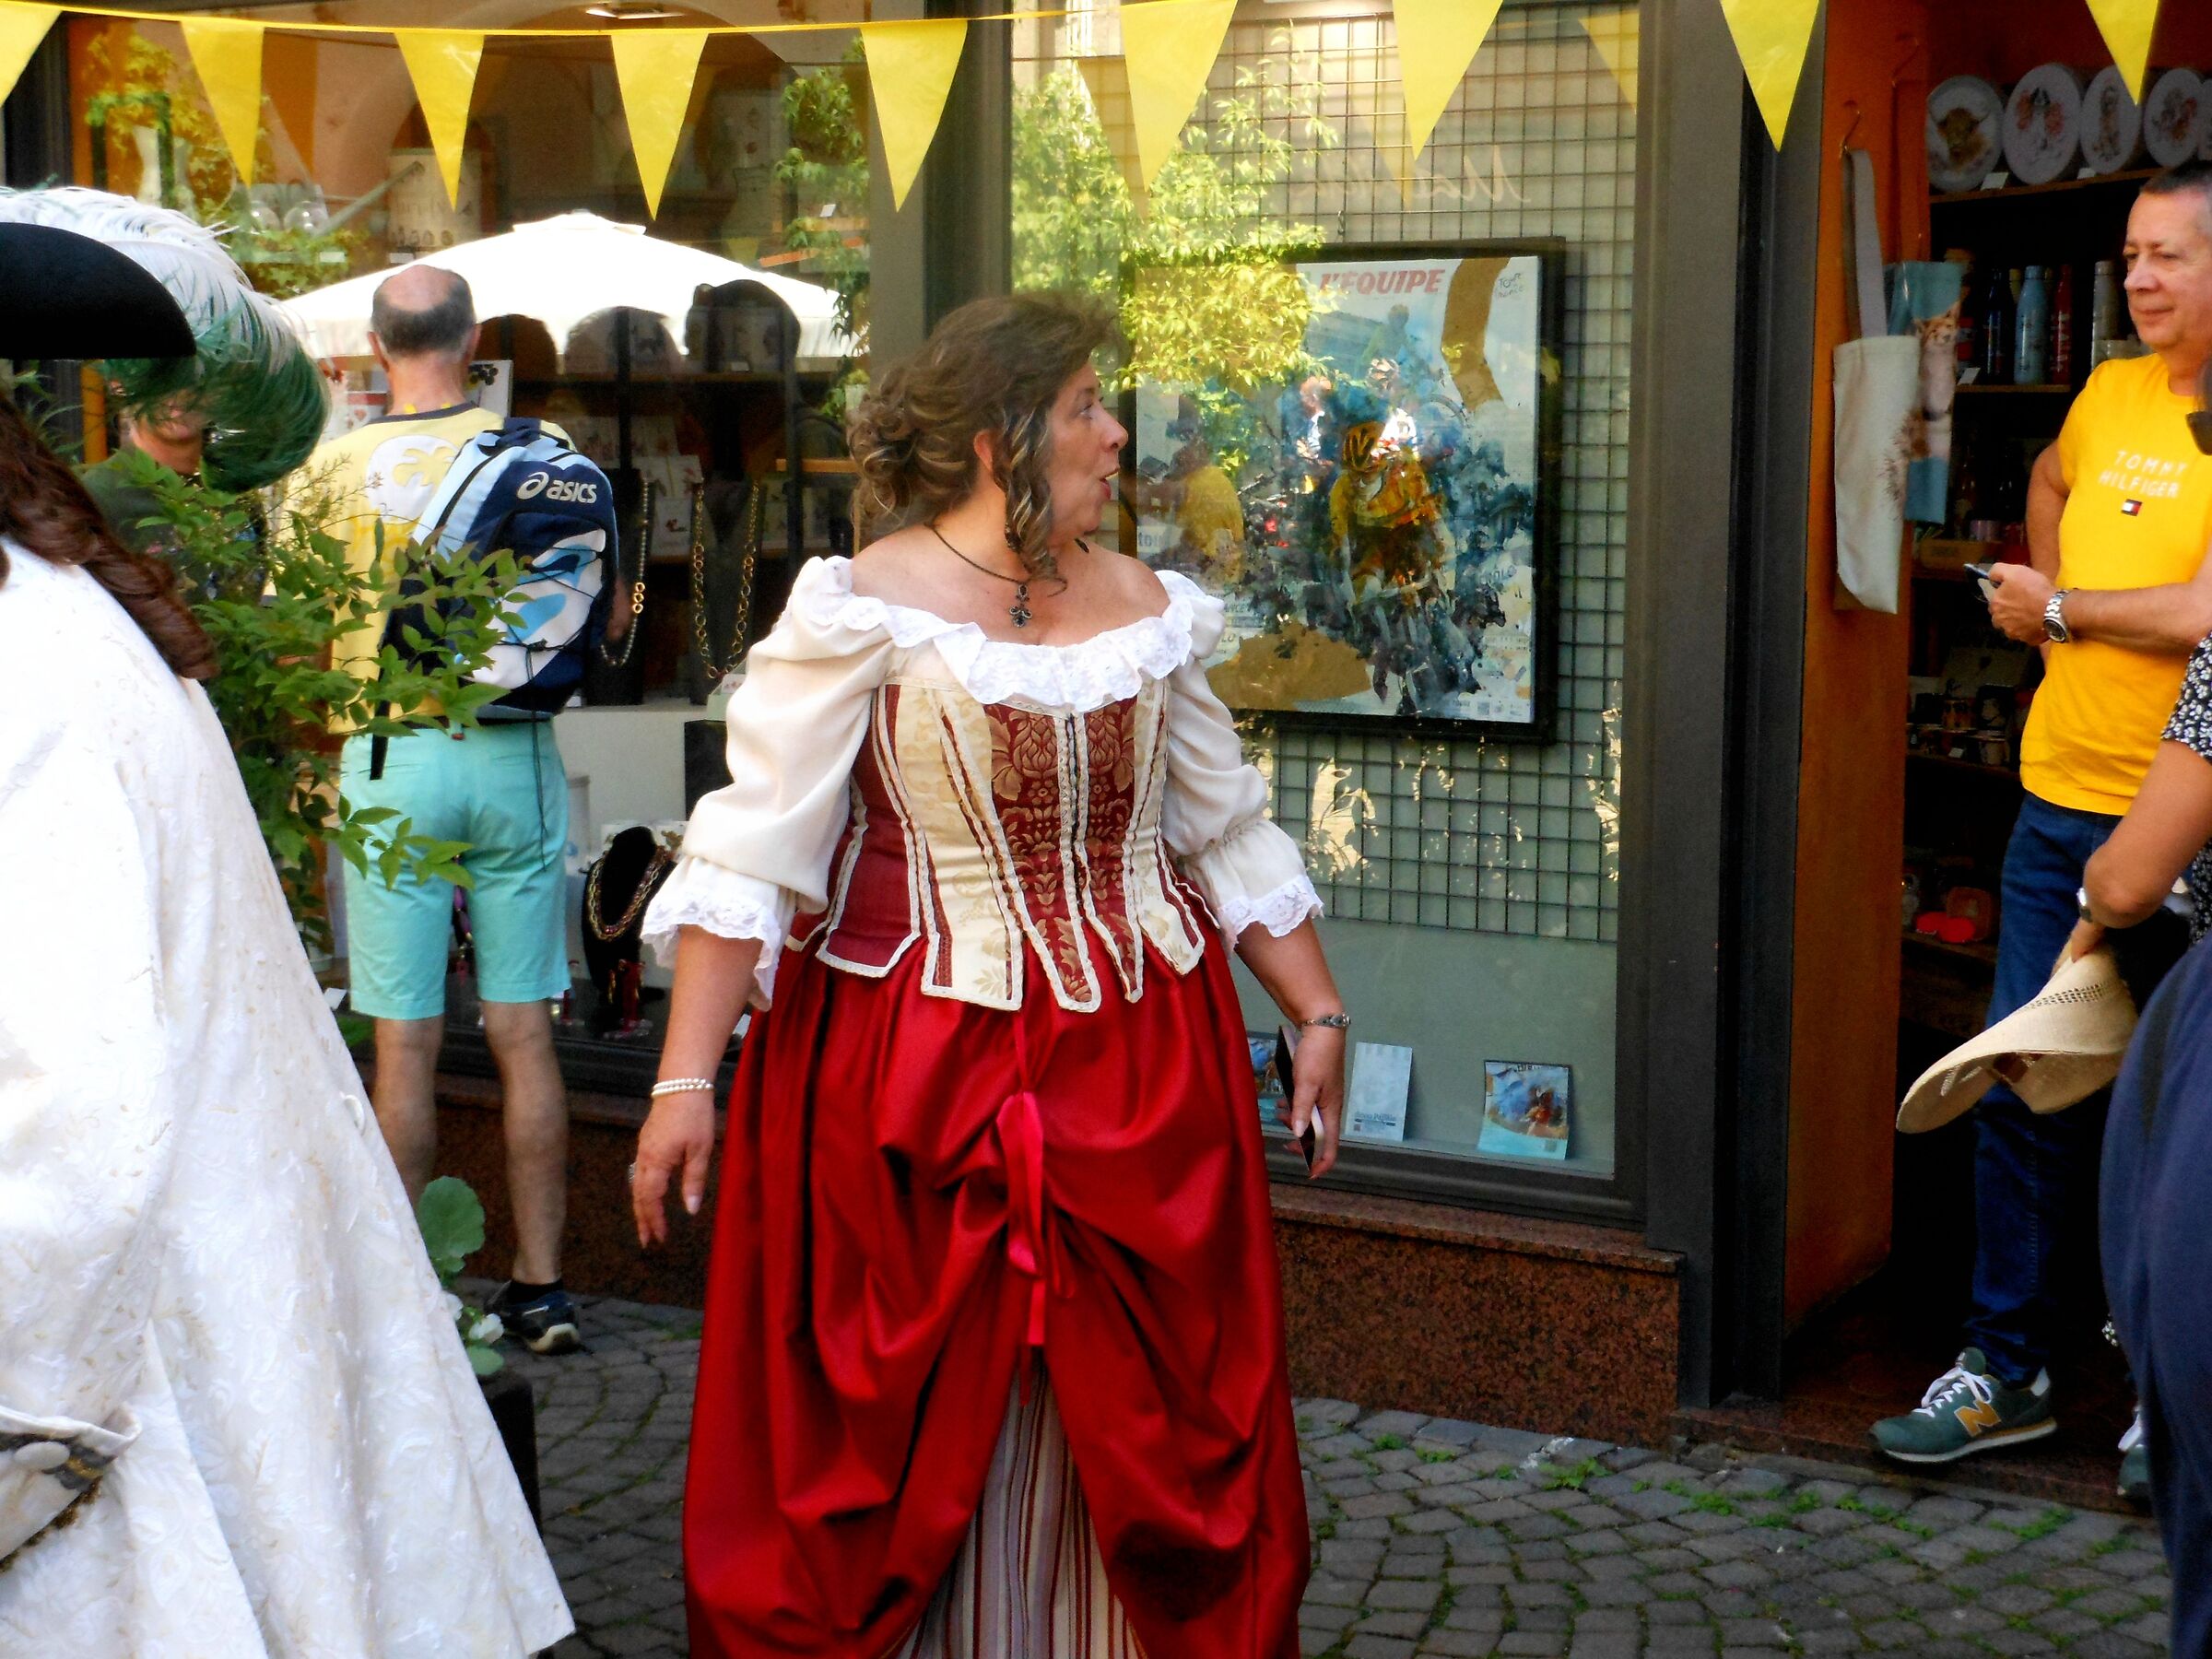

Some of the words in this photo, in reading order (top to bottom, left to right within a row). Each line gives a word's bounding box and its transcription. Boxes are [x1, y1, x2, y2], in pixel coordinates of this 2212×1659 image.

[2114, 450, 2188, 477] TOMMY
[2098, 470, 2180, 498] HILFIGER
[1954, 1400, 2001, 1437] N
